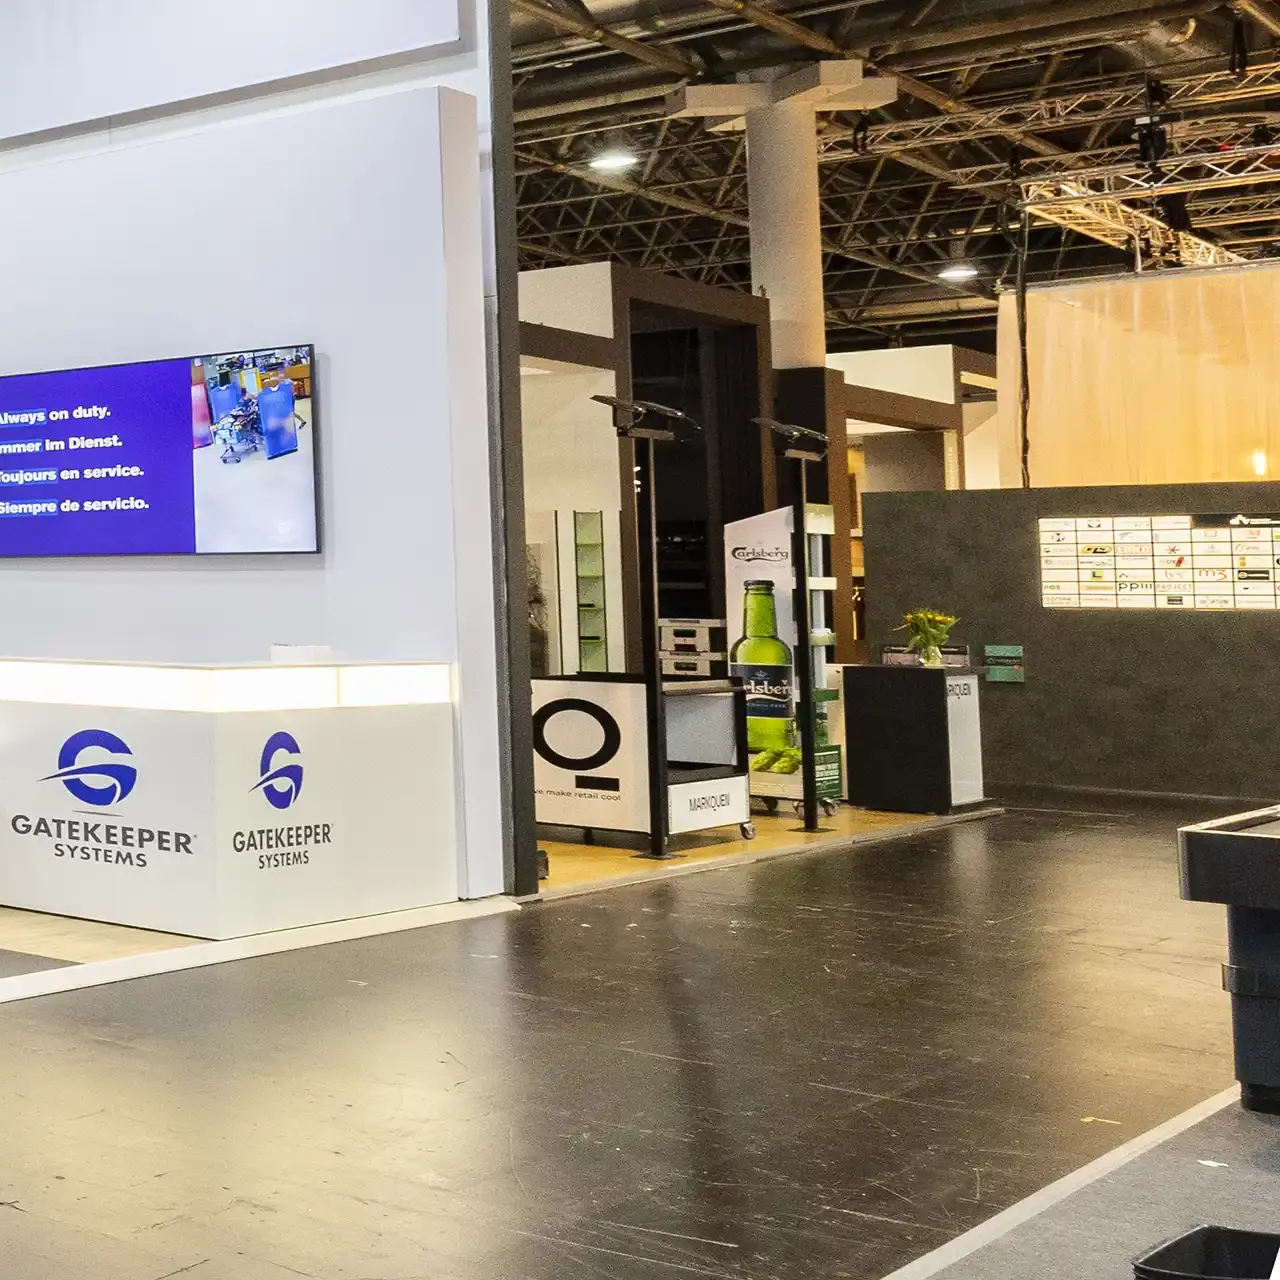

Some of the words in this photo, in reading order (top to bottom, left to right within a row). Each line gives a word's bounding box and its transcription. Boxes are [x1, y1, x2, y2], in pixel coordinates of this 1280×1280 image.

[48, 410, 69, 420] on
[72, 405, 111, 419] duty.
[45, 439, 65, 451] im
[69, 434, 123, 450] Dienst.
[60, 469, 80, 479] en
[83, 464, 144, 478] service.
[60, 499, 80, 512] de
[83, 497, 149, 511] servicio.
[731, 547, 789, 562] Carlsberg
[546, 789, 572, 797] make
[53, 843, 148, 868] SYSTEMS
[258, 850, 309, 870] SYSTEMS
